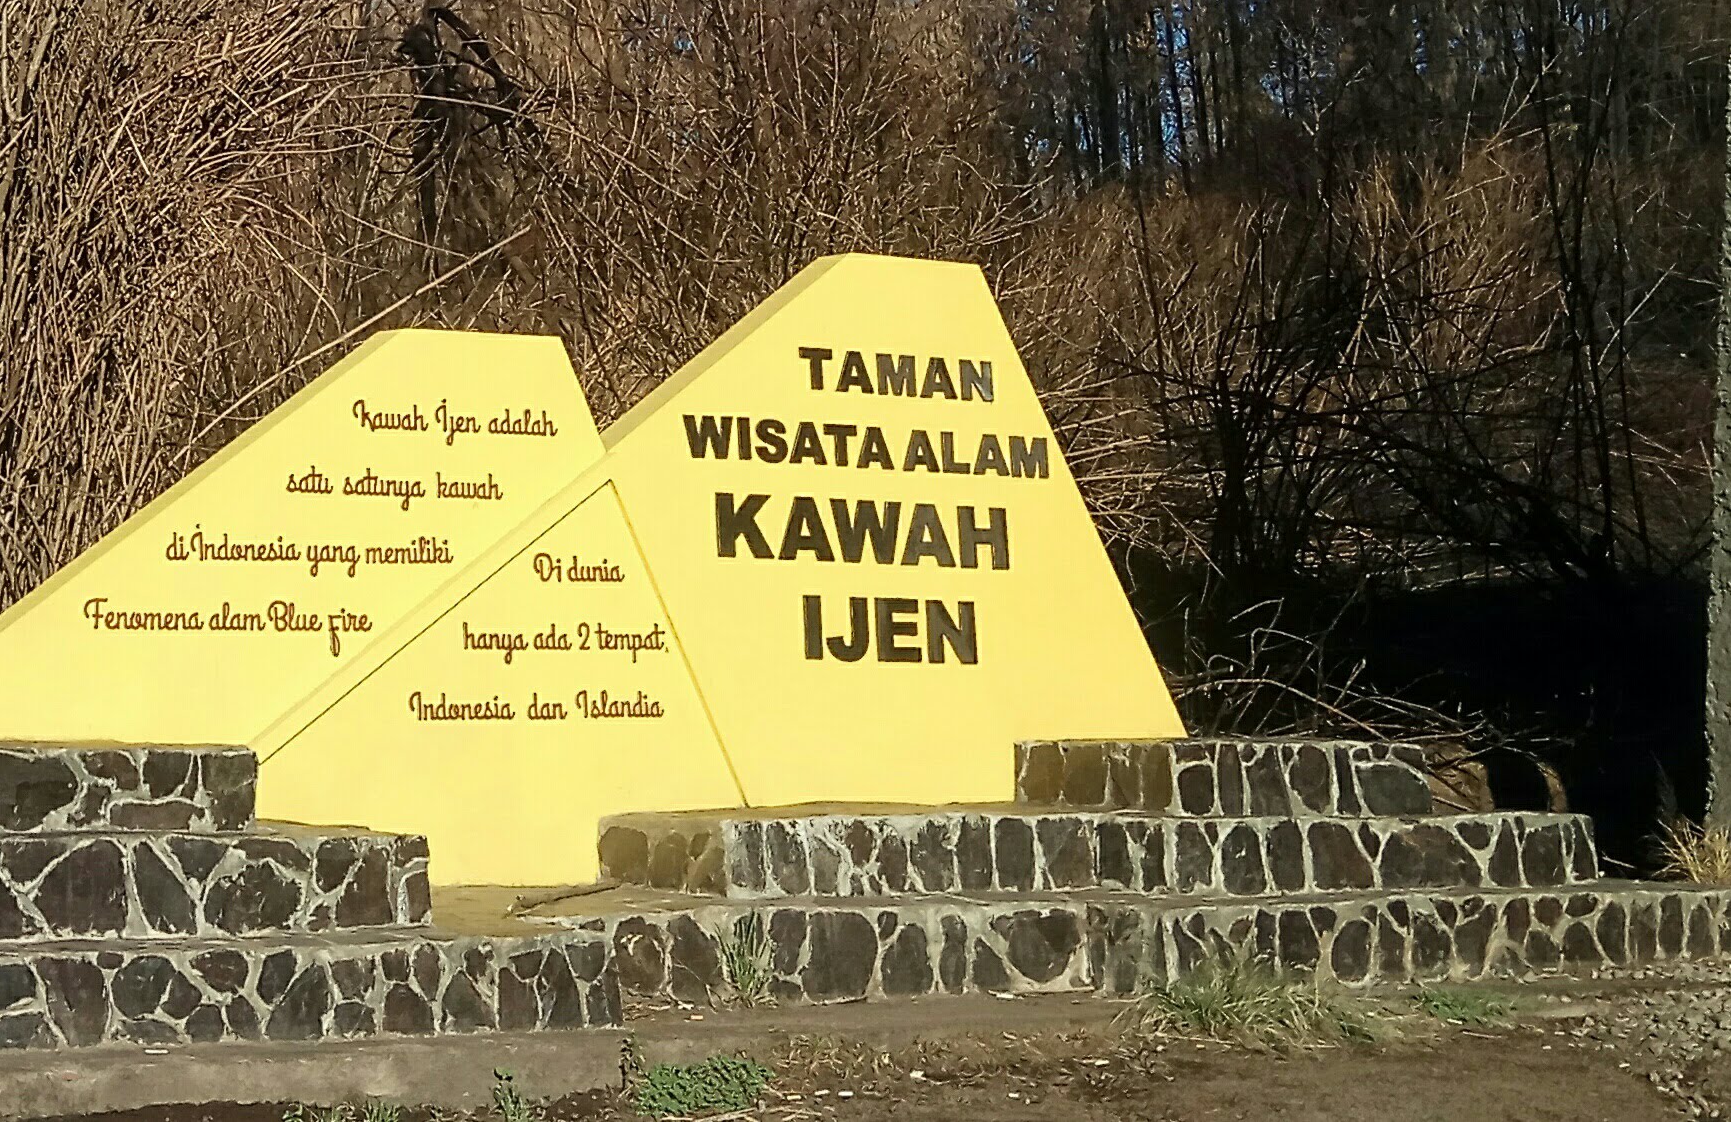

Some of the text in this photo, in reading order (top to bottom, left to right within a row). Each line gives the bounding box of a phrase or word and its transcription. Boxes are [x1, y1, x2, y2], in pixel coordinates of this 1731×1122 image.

[798, 346, 994, 403] TAMAN
[352, 399, 428, 432] Kawah
[488, 409, 559, 437] adalah
[682, 414, 1050, 479] WISATA ALAM
[286, 466, 504, 511] satu satunya kawah
[714, 492, 1010, 571] KAWAH
[166, 532, 190, 561] di
[306, 541, 360, 578] yang
[365, 536, 454, 564] memiliki
[532, 553, 625, 583] Di dunia
[83, 597, 373, 657] Fenomena alam Blue fire
[462, 621, 528, 665] hanya
[533, 623, 572, 651] ada
[577, 622, 591, 650] 2
[802, 595, 978, 666] IJEN
[409, 689, 665, 721] Indonesia dan Islandia
